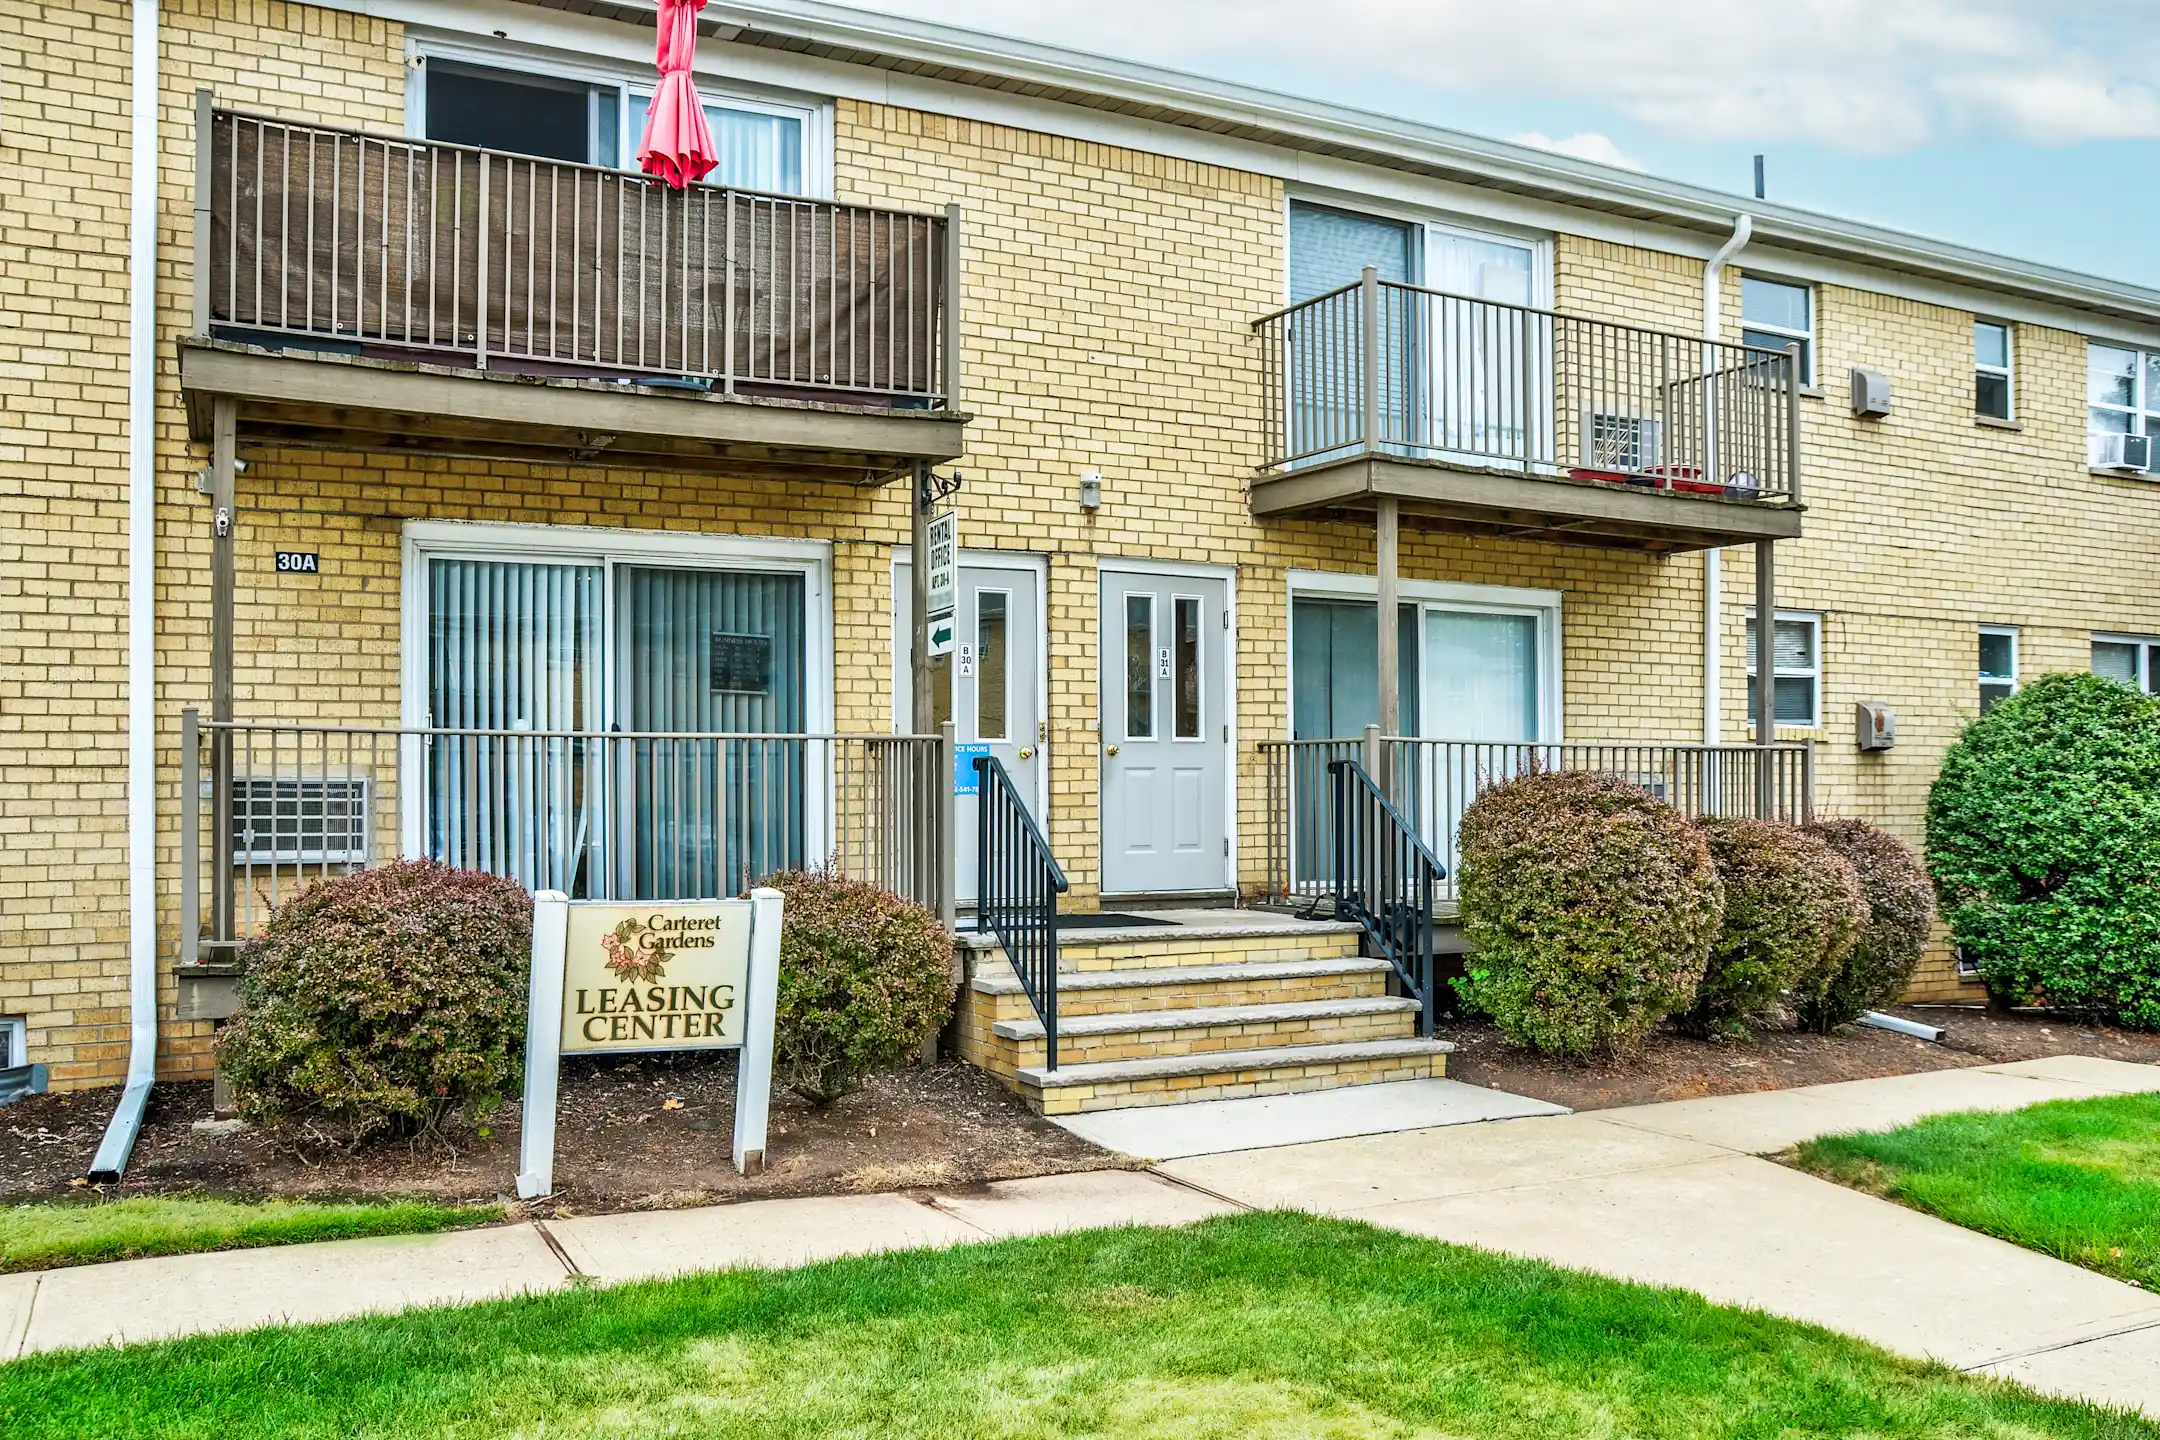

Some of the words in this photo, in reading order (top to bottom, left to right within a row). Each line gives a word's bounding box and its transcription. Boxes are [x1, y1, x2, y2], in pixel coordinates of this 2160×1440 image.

[930, 519, 951, 547] RENTAL
[278, 553, 316, 571] 30A
[931, 543, 950, 571] OFFICE
[963, 646, 969, 655] B
[961, 655, 972, 664] 30
[1160, 659, 1169, 667] 31
[963, 665, 969, 673] A
[954, 745, 966, 753] ICE
[966, 745, 988, 753] HOURS
[648, 914, 721, 931] Carteret
[639, 932, 715, 949] Gardens
[576, 985, 735, 1014] LEASING
[583, 1012, 726, 1042] CENTER
